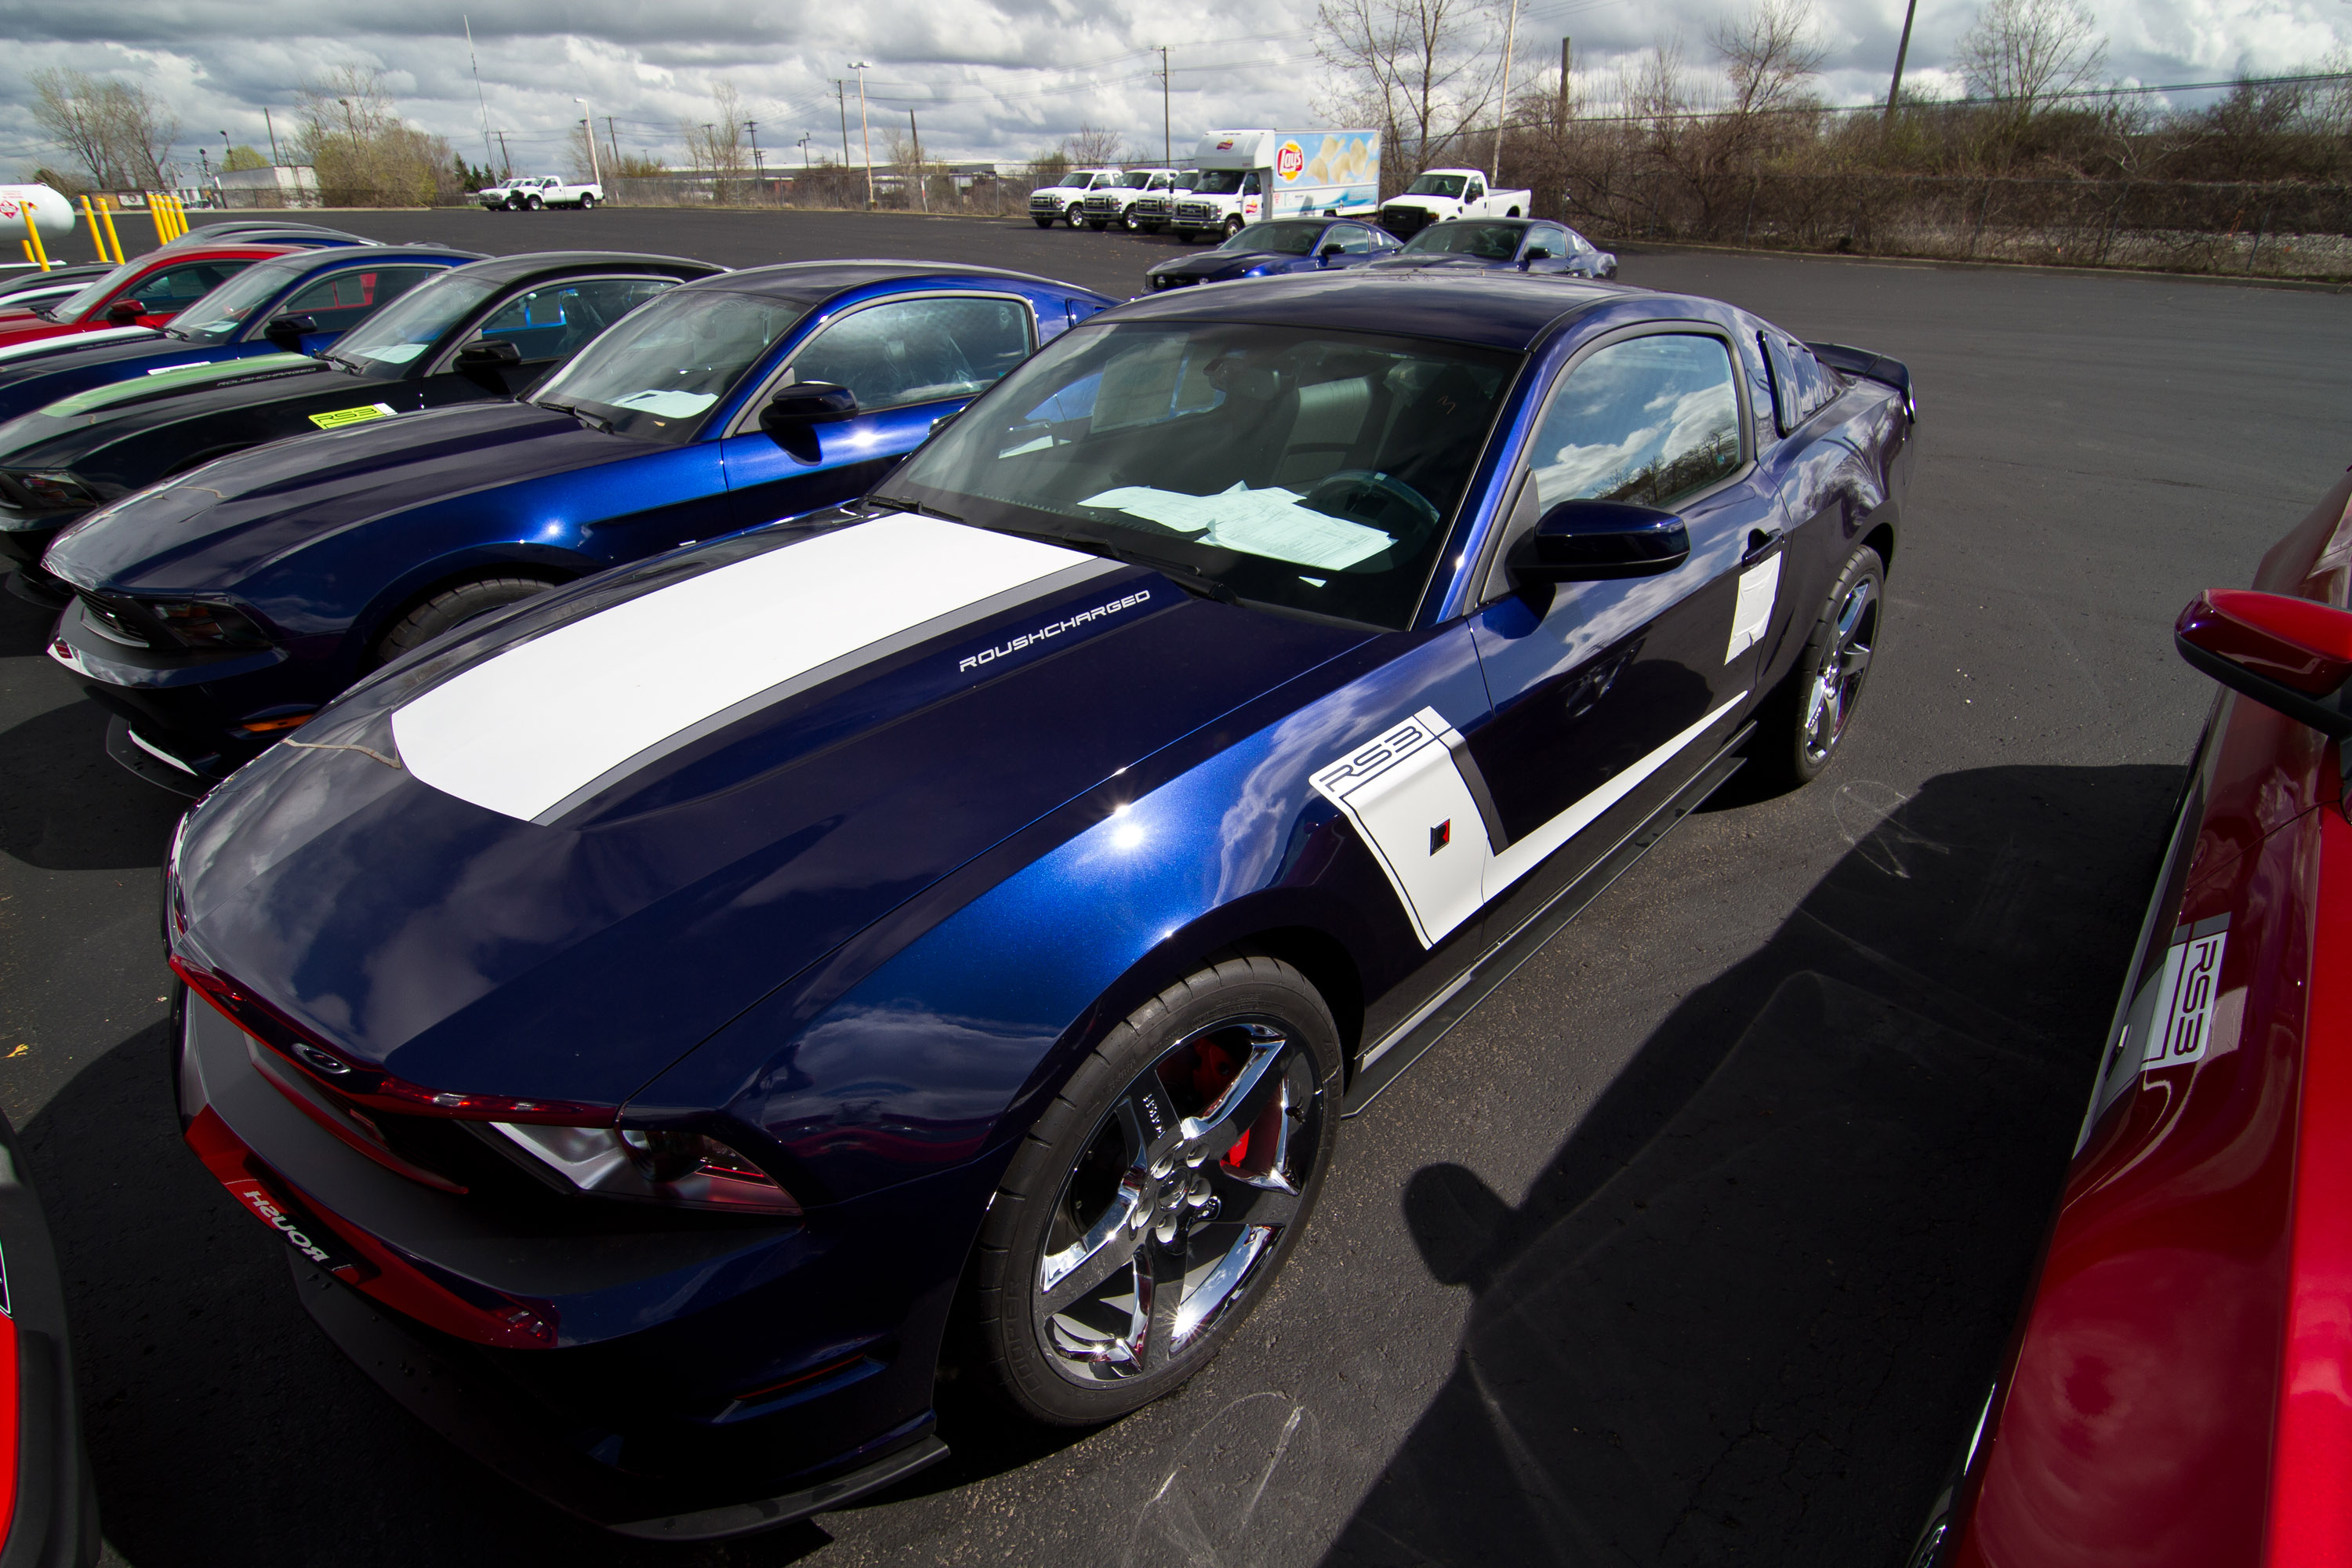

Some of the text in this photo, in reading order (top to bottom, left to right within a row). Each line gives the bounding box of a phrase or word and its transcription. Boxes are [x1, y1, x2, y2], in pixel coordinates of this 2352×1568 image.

[314, 408, 378, 423] RS3
[959, 590, 1151, 673] ROUSHCHARGED
[1318, 725, 1423, 793] RS3
[2173, 940, 2219, 1056] RS3
